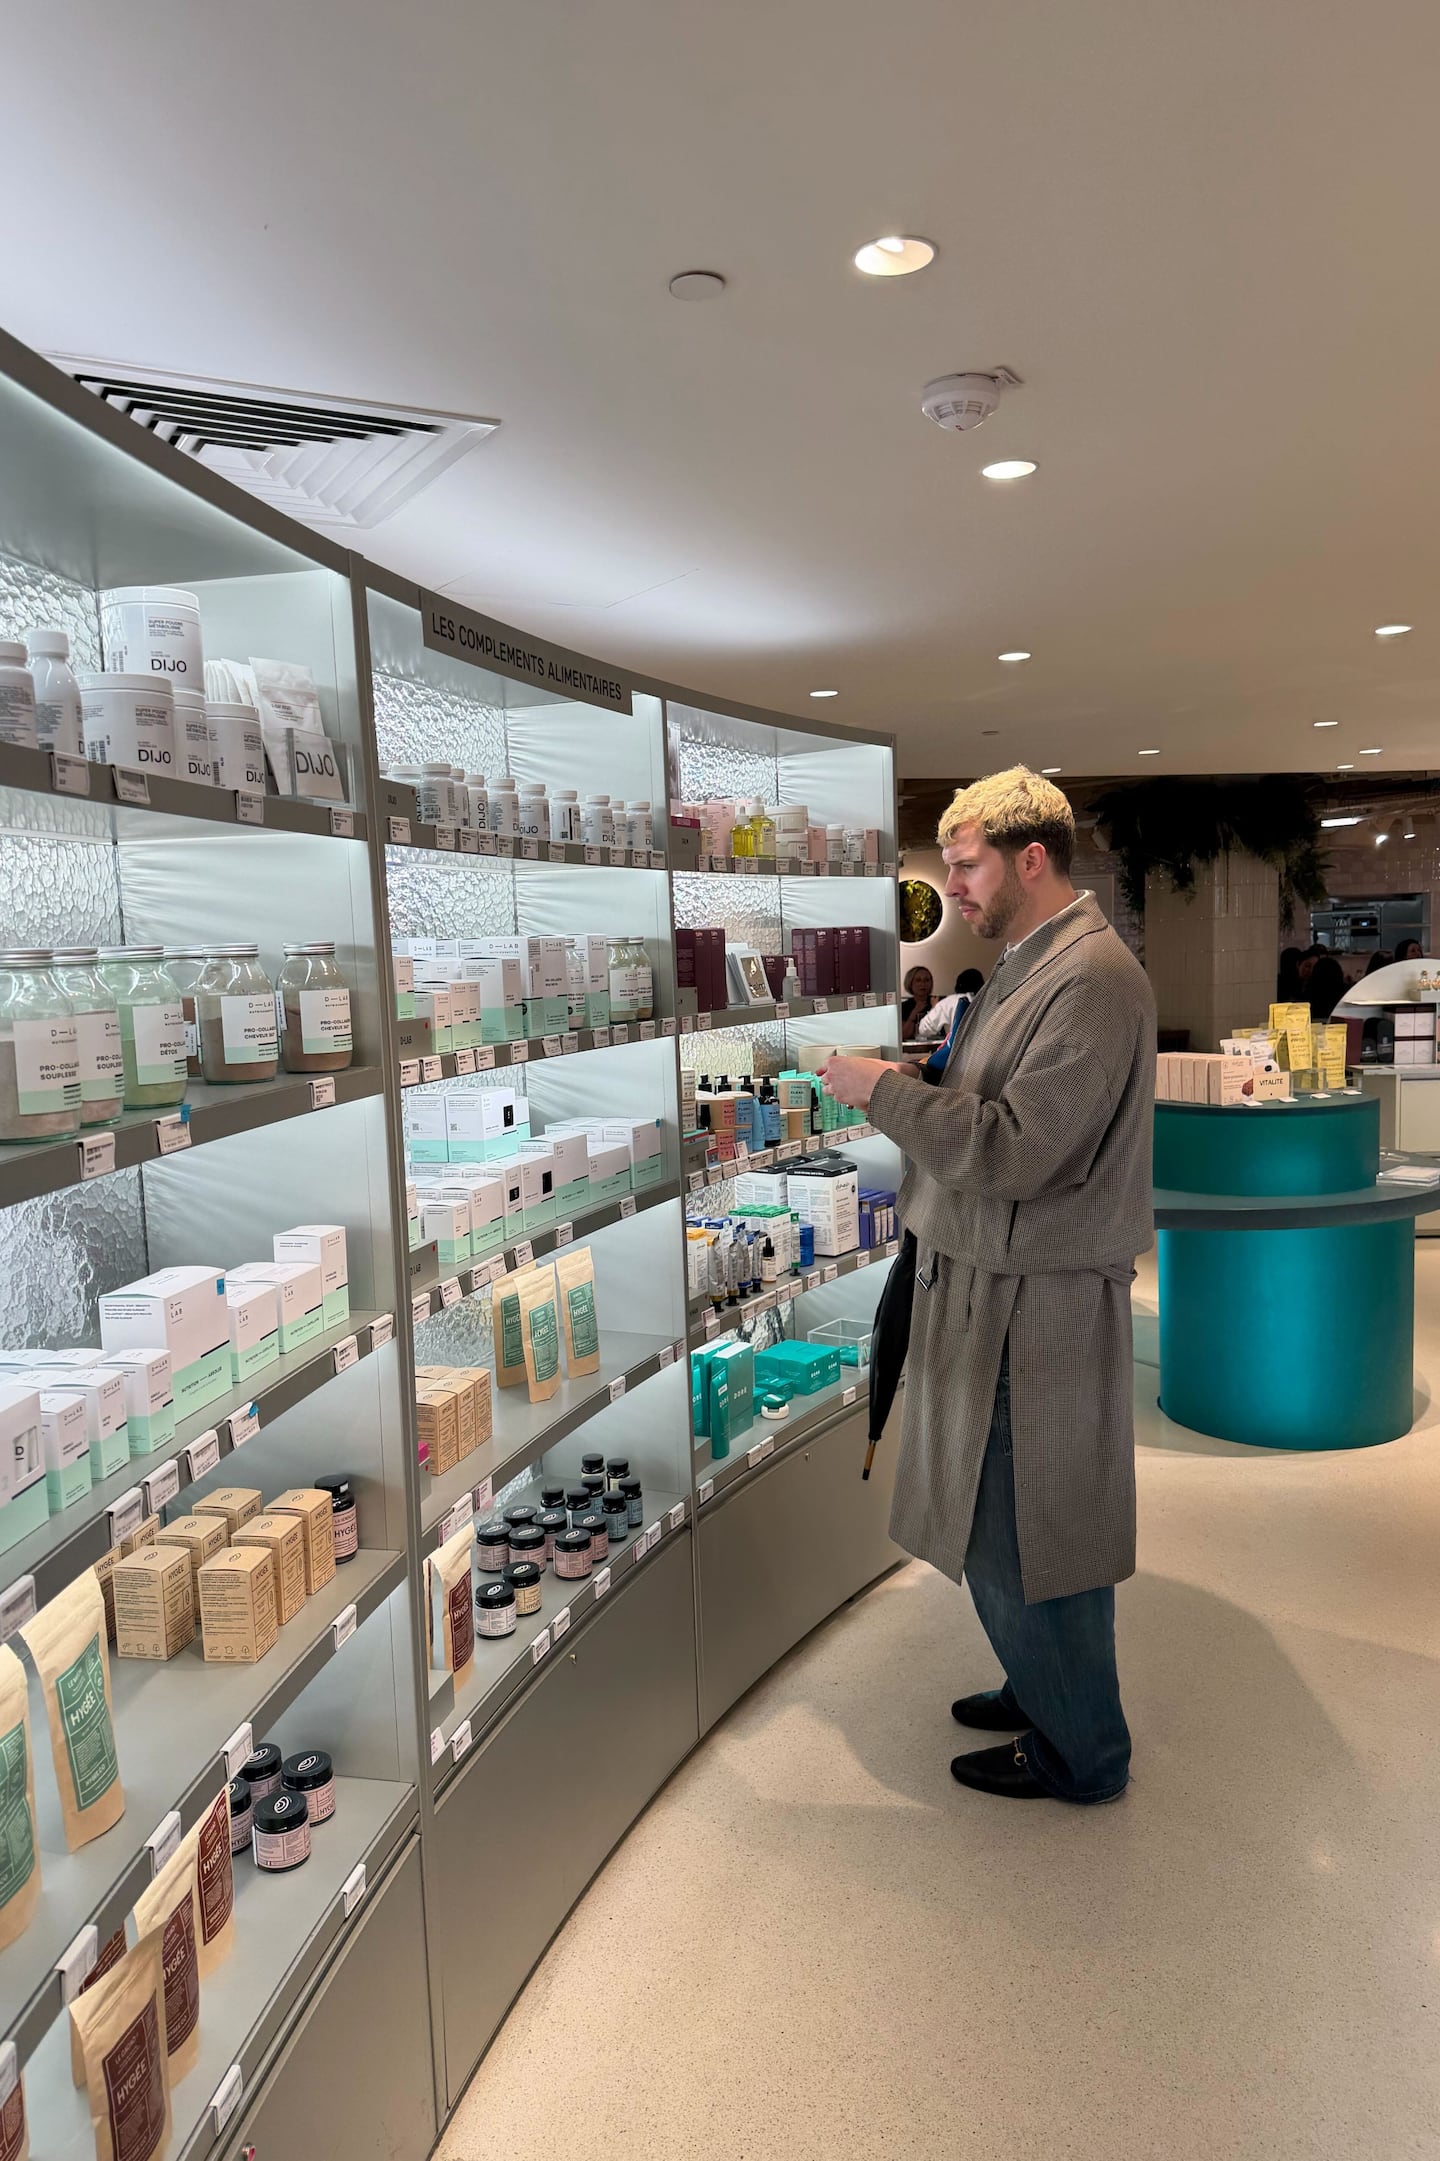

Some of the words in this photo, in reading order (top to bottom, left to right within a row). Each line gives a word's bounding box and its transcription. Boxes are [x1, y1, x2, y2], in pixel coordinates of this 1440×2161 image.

[432, 612, 455, 641] LES
[459, 625, 544, 676] COMPLEMENTS
[548, 661, 622, 700] ALIMENTAIRES
[151, 659, 187, 673] DIJO
[138, 749, 171, 764] DIJO
[295, 751, 334, 777] DIJO
[188, 762, 211, 776] DIJO
[477, 802, 486, 829] DIJO
[170, 1308, 183, 1319] LAB
[140, 1527, 156, 1544] HYGÉE
[208, 1532, 222, 1548] HYGÉE
[97, 1556, 114, 1574] HYGÉE
[168, 1564, 185, 1582] HYGÉE
[70, 1690, 96, 1726] HYGÉE
[203, 1842, 223, 1874] HYGÉE
[117, 2057, 147, 2104] HYGÉE
